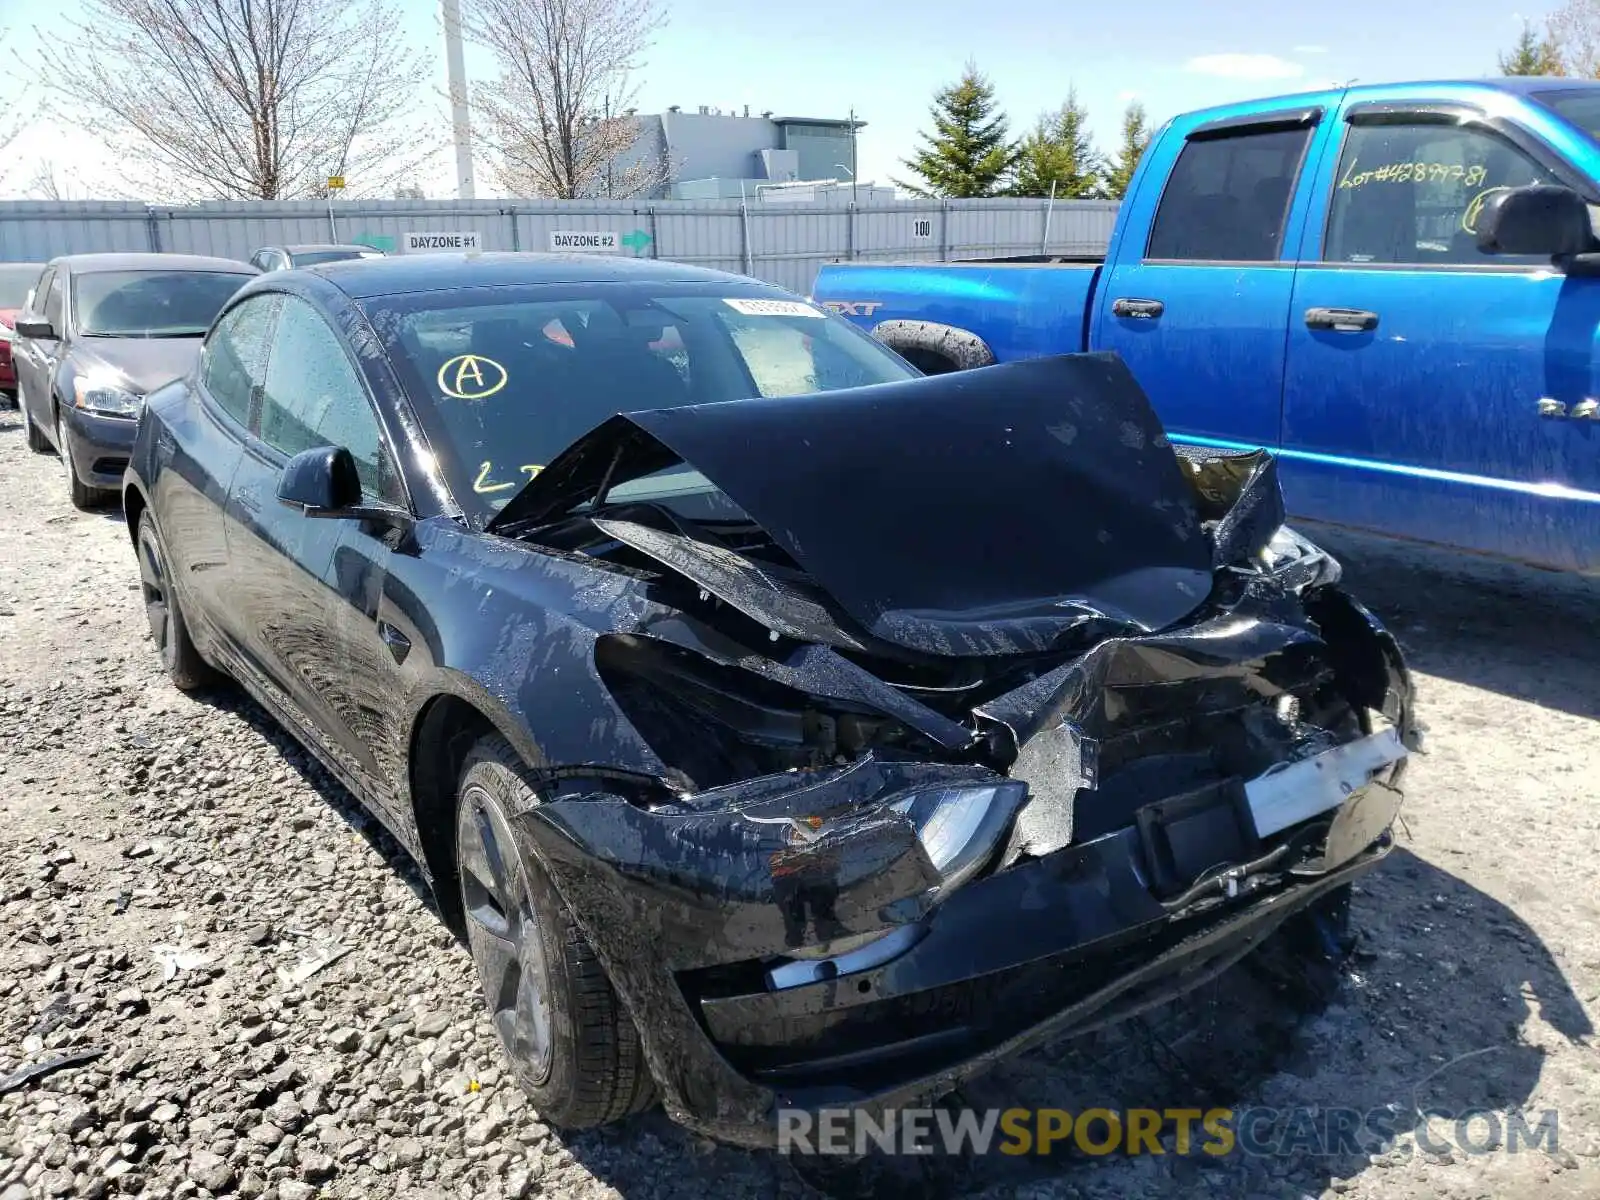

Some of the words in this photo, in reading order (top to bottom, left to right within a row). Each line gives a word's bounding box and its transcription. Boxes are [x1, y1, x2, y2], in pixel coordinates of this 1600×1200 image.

[914, 221, 930, 236] 100
[410, 237, 461, 248] DAYZONE
[463, 236, 475, 248] #1
[555, 235, 600, 247] DAYZONE
[602, 236, 615, 247] #2
